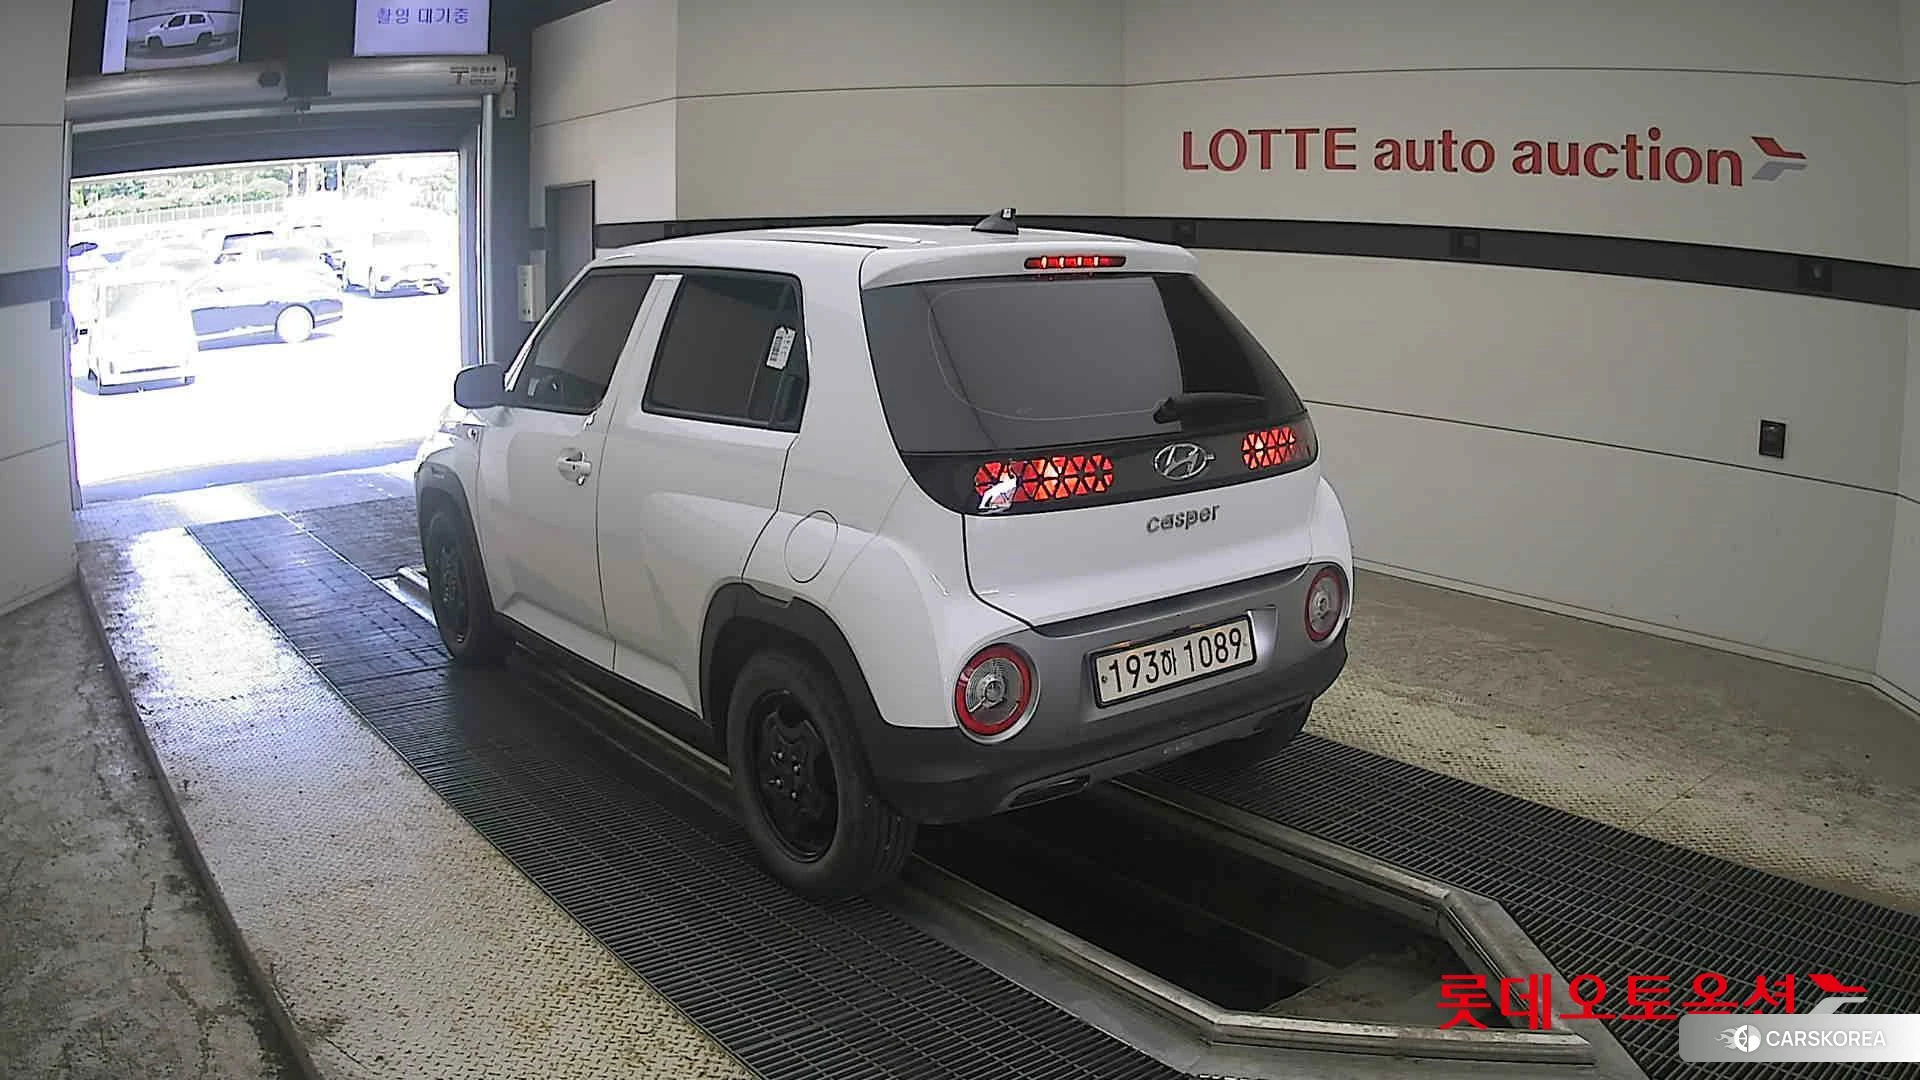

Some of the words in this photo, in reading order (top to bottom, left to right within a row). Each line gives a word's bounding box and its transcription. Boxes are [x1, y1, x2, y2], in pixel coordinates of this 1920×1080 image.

[418, 7, 470, 25] 대기중
[1182, 127, 1358, 172] LOTTE
[1374, 129, 1496, 173] auto
[1511, 126, 1744, 187] auction
[1146, 504, 1221, 533] casper
[1109, 647, 1178, 693] 193하
[1183, 627, 1242, 673] 1089
